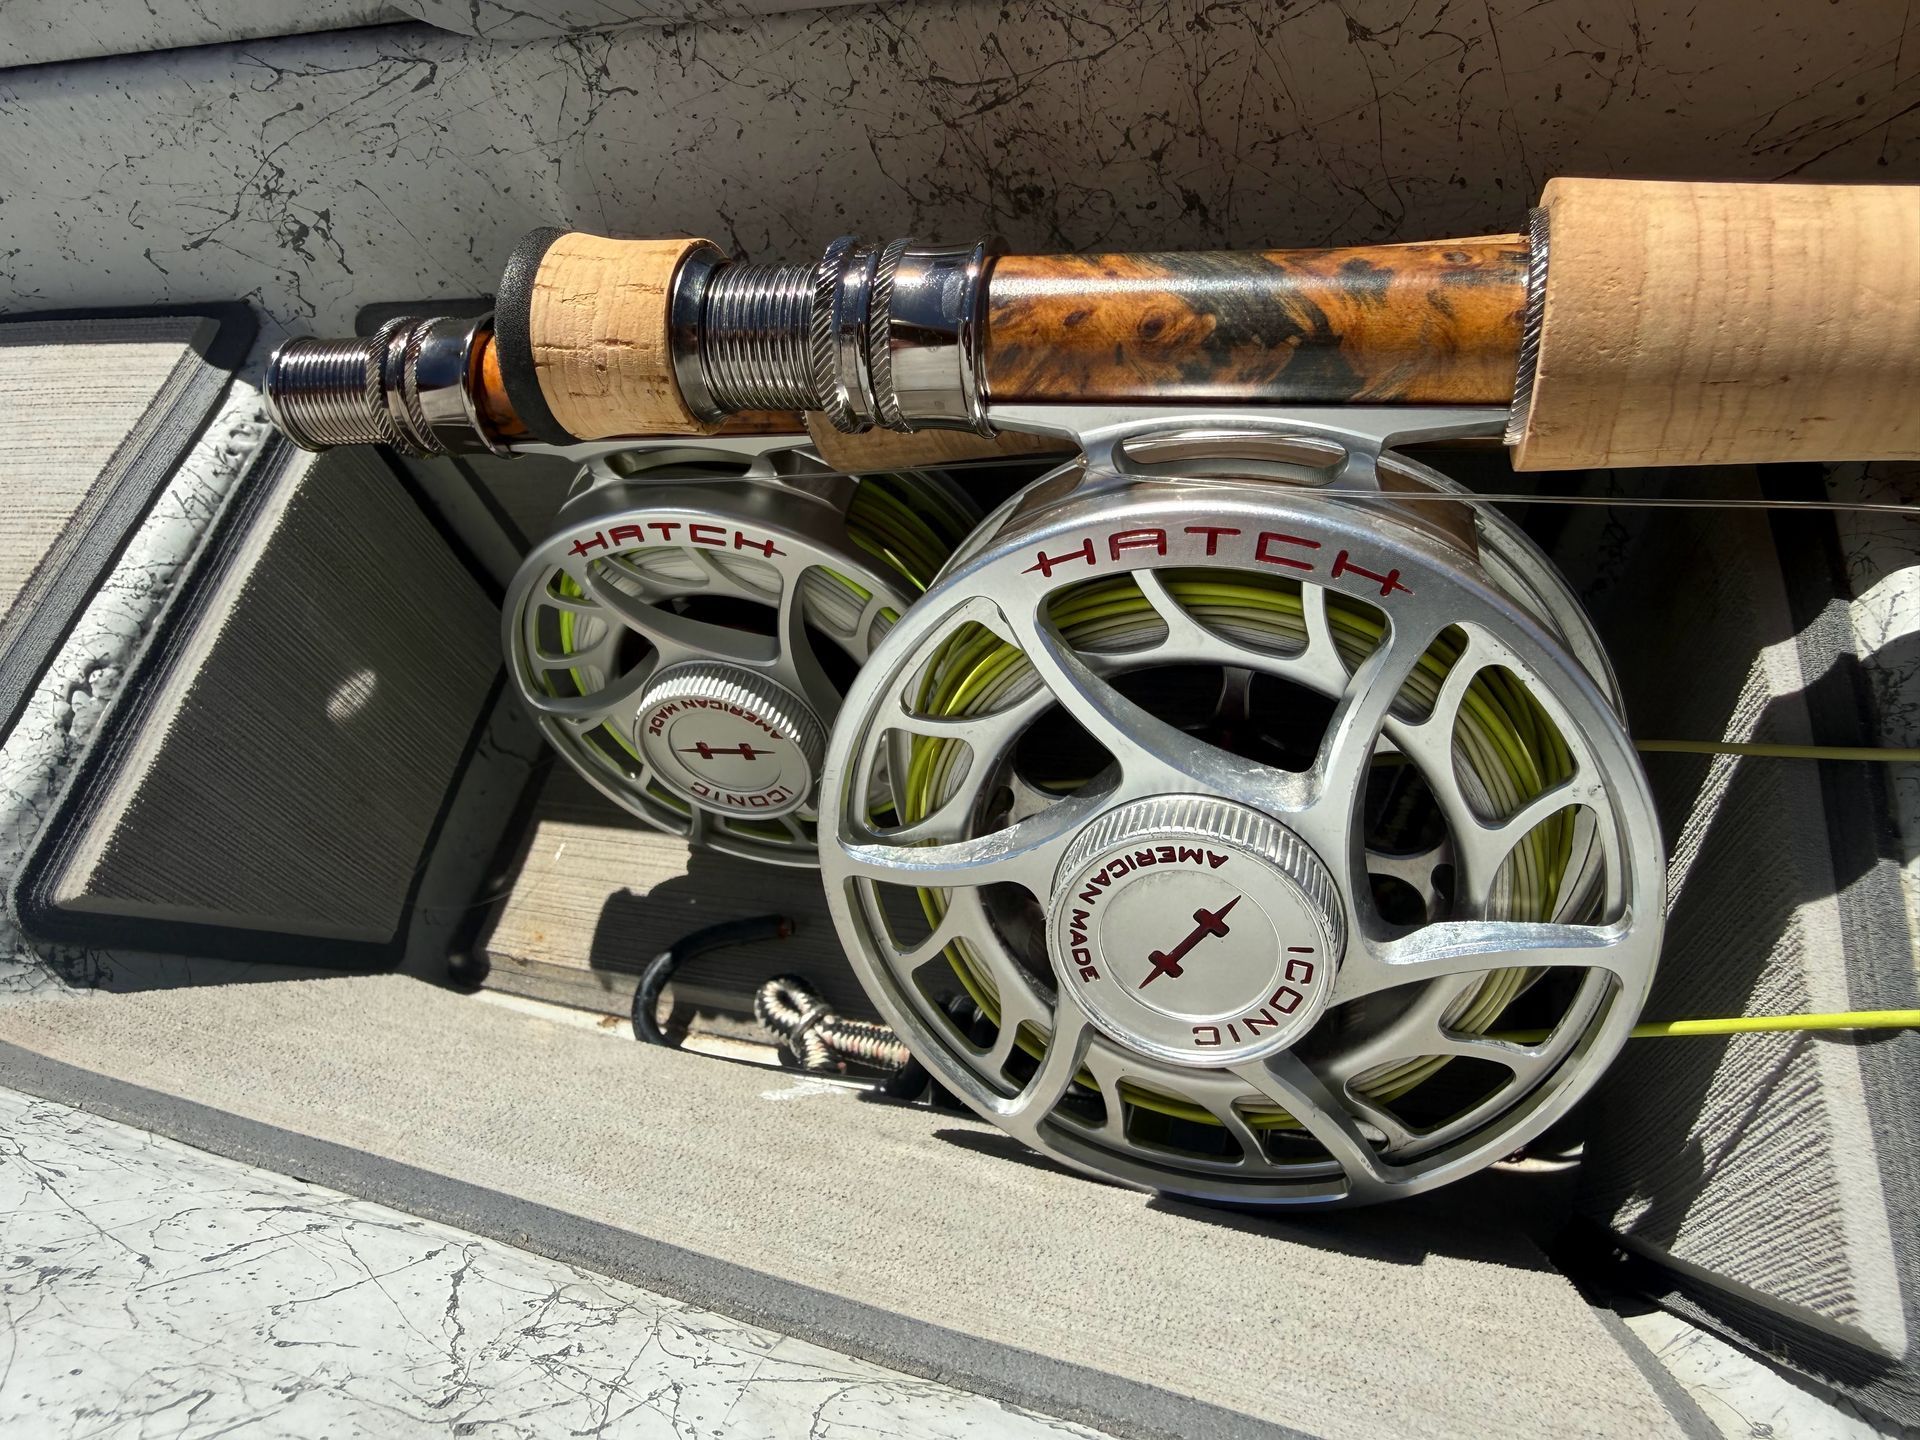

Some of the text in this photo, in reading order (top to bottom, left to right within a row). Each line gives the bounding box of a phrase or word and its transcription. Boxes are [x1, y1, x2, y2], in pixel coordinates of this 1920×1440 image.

[567, 522, 788, 558] HATCH
[1020, 526, 1415, 597] HATCH
[648, 698, 784, 740] AMERICAN MADE
[690, 781, 794, 808] ICONIC
[1069, 845, 1230, 983] AMERICAN MADE
[1192, 945, 1315, 1047] ICONIC
